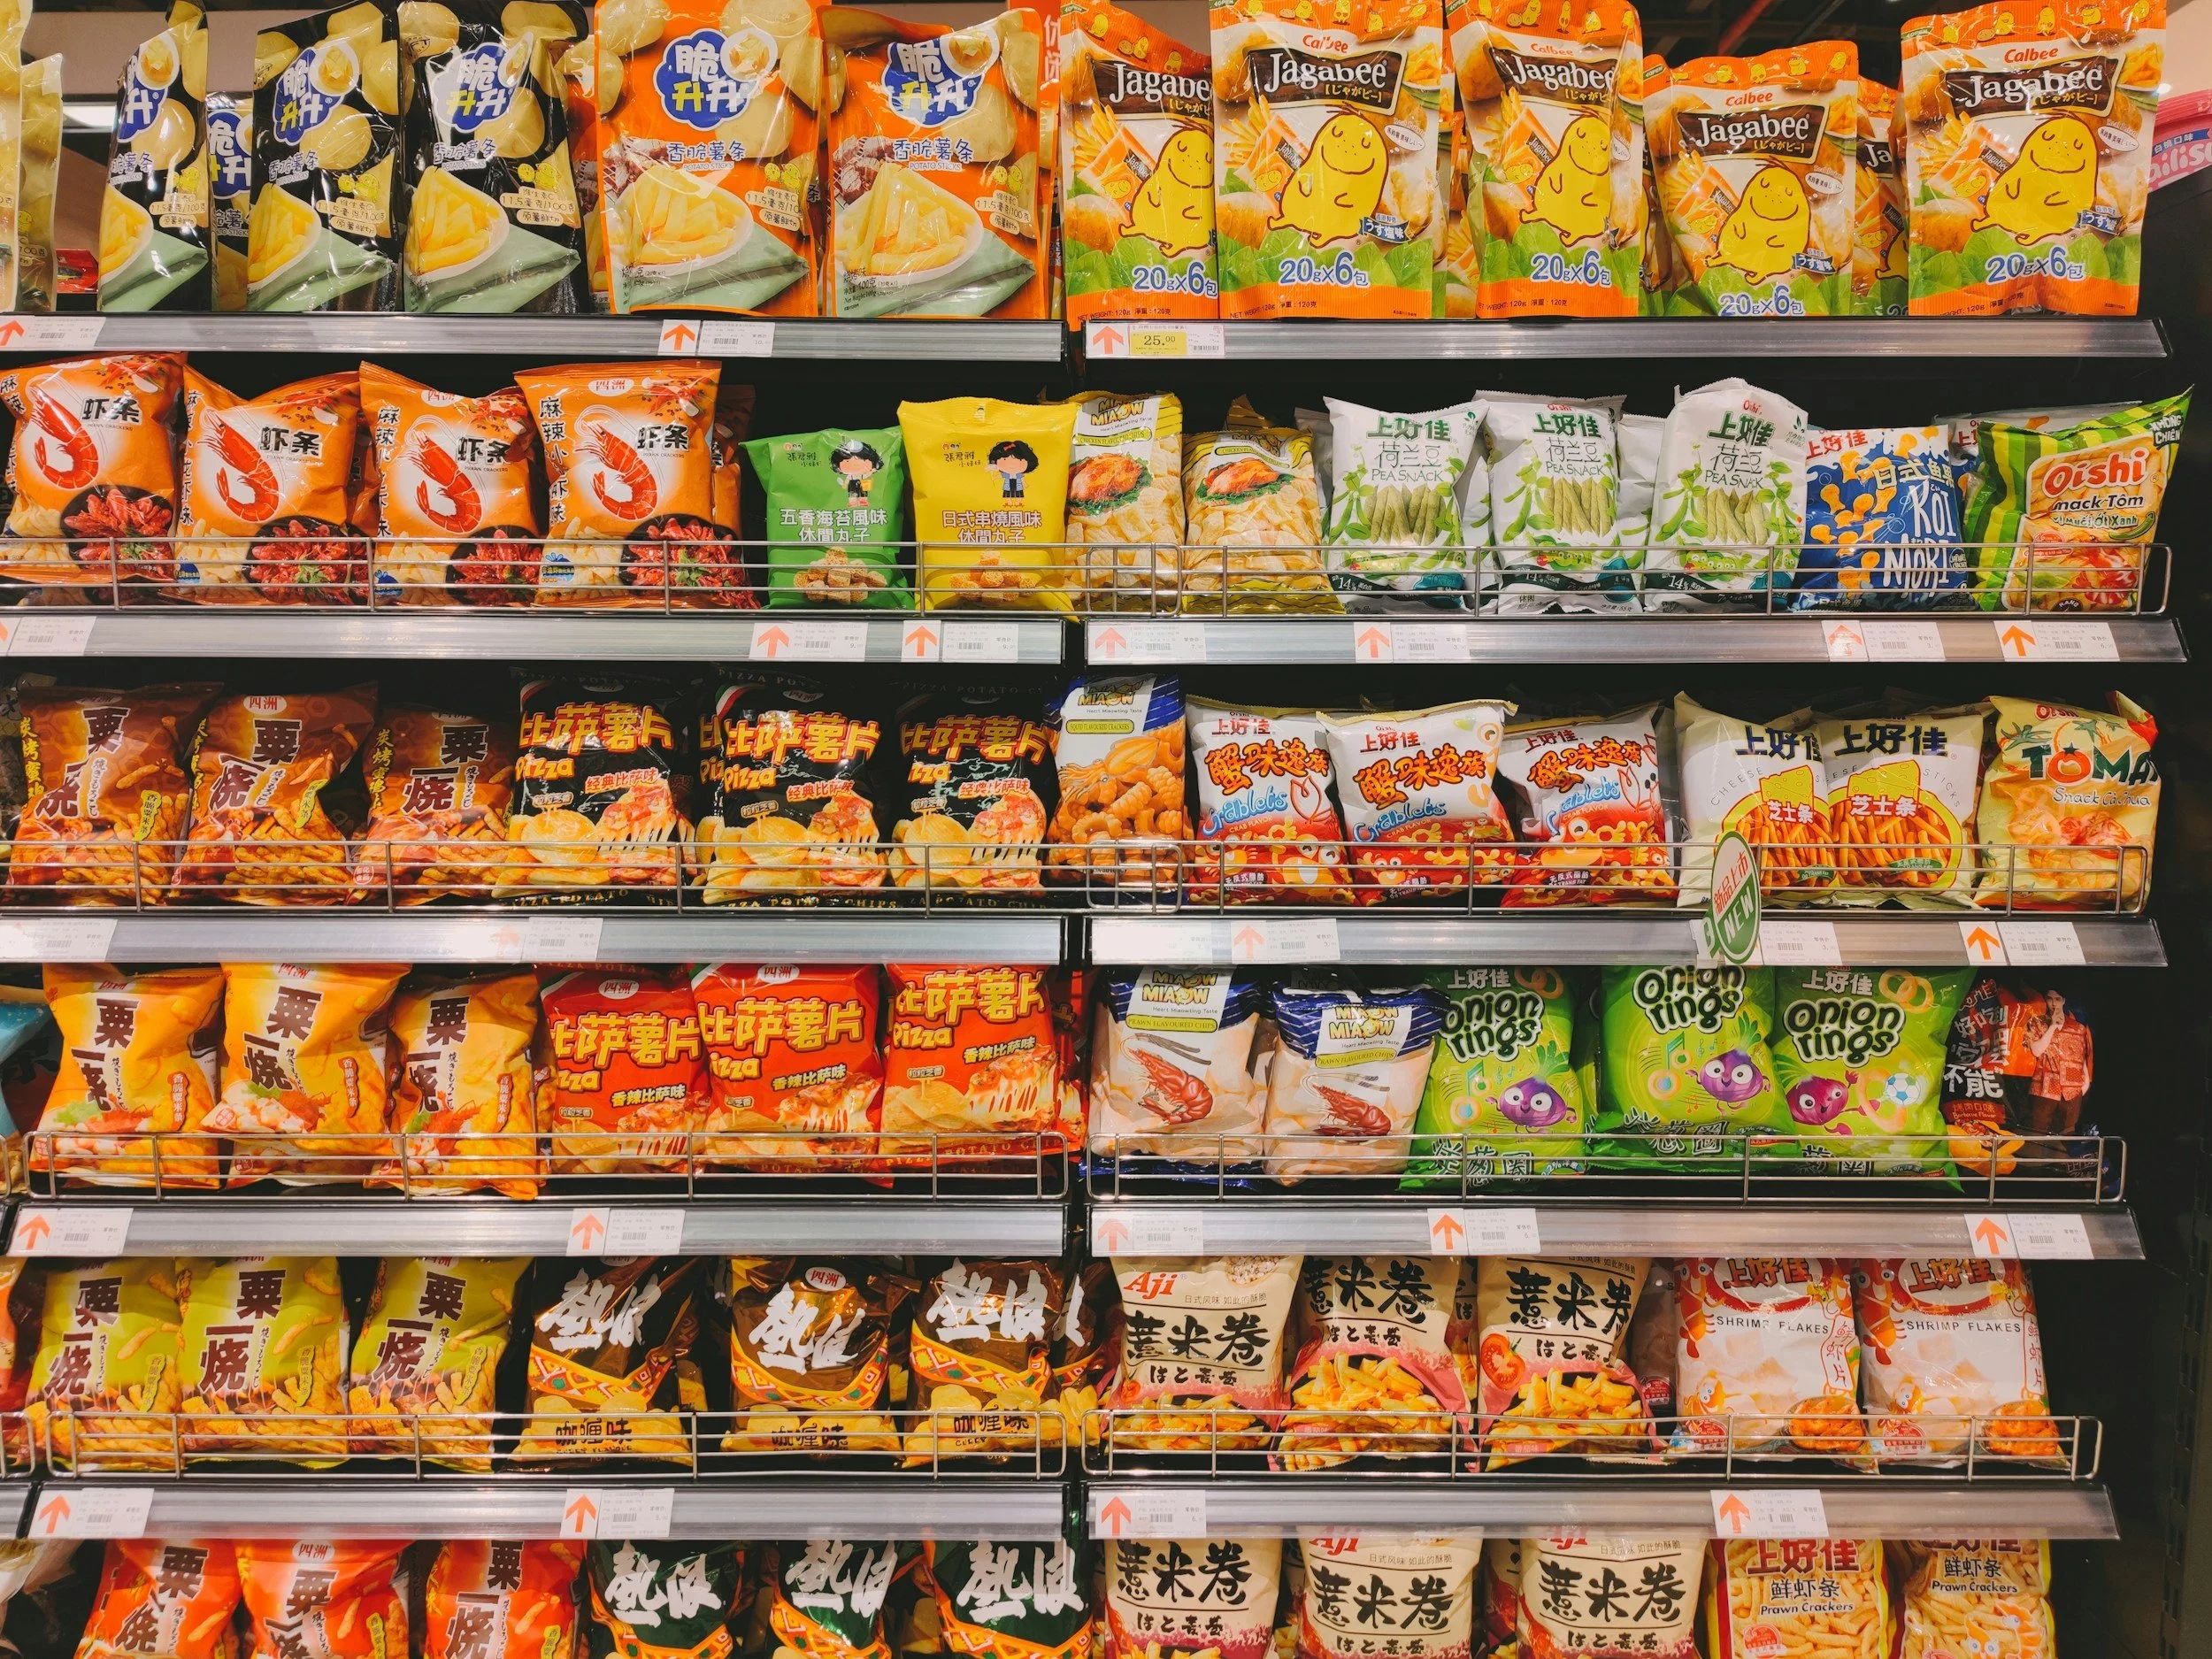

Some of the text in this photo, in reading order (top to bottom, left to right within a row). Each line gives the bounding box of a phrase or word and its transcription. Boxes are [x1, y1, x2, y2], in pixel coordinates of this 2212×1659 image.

[1303, 34, 1348, 53] Calbee
[1531, 42, 1574, 56] Calbee
[2004, 47, 2059, 64] Calbee
[675, 40, 721, 82] 脆
[897, 42, 944, 83] 脆
[1264, 53, 1388, 90] Jagabee
[1512, 54, 1616, 90] Jagabee
[672, 80, 746, 112] 升升
[899, 80, 968, 112] 升升
[1725, 91, 1773, 107] Calbee
[1965, 66, 2104, 107] Jagabee
[1695, 113, 1811, 148] Jagabee
[668, 141, 746, 162] 香脆薯条
[894, 138, 973, 162] 香脆薯条
[2154, 133, 2194, 155] 白桃口味
[1143, 333, 1176, 347] 25.00
[82, 397, 142, 423] 虾条
[1090, 401, 1144, 426] MIAOW
[636, 424, 691, 451] 虾条
[1366, 417, 1453, 442] 上好佳
[1532, 412, 1602, 439] 上好佳
[2155, 430, 2180, 445] CHIÊN
[259, 425, 322, 458] 虾条
[457, 435, 511, 465] 虾条
[1546, 438, 1602, 463] 荷兰豆
[1806, 429, 1869, 459] 上好佳
[943, 451, 975, 463] 張君雅
[1375, 442, 1442, 469] 荷兰豆
[1371, 468, 1444, 483] PEA SNACK
[1546, 461, 1606, 477] PEA SNACK
[1704, 469, 1729, 487] PEA
[2042, 449, 2150, 497] Oishi
[1909, 480, 1957, 537] KOI
[2108, 494, 2144, 508] Tôm
[780, 509, 888, 526] 五香海苔風味
[942, 511, 1042, 528] 日式串燒風味
[2109, 516, 2138, 529] Xanh
[249, 695, 278, 710] 四洲
[1078, 692, 1135, 706] MIAOW
[519, 704, 673, 753] 比萨薯片
[723, 713, 882, 764] 比萨薯片
[901, 717, 1047, 762] 比萨薯片
[1211, 718, 1271, 736] 上好佳
[1360, 730, 1421, 754] 上好佳
[1525, 729, 1578, 754] 上好佳
[1834, 723, 1948, 757] 上好佳
[516, 756, 573, 780] Pizza
[1204, 737, 1329, 795] 蟹味逸族
[1353, 743, 1487, 810] 蟹味逸族
[585, 768, 658, 793] 经典比萨味
[724, 766, 778, 793] Pizza
[786, 780, 855, 802] 经典比萨味
[957, 780, 1031, 800] 经典比萨味
[1710, 765, 1763, 807] CHEESE
[1922, 767, 1962, 808] STICKS
[1850, 795, 1917, 818] 芝士条
[2054, 786, 2100, 805] Snack
[1202, 786, 1288, 837] Crablets
[1353, 798, 1447, 843] Crablets
[1583, 803, 1609, 815] FLAVOR
[1769, 801, 1815, 825] 芝士条
[1228, 816, 1273, 833] CRAB FLAVOR
[1386, 818, 1432, 839] CRAB FLAVOR
[1548, 869, 1590, 887] 无反式脂肪
[1713, 849, 1749, 916] 新品上市
[1723, 887, 1755, 945] NEW
[764, 965, 793, 979] 四洲
[1447, 969, 1511, 990] 上好佳
[1801, 970, 1874, 996] 上好佳
[603, 983, 633, 995] 四洲
[895, 968, 1045, 1023] 比萨薯片
[1142, 984, 1210, 1004] MIAOW
[1440, 991, 1543, 1033] onion
[1649, 987, 1743, 1033] rings
[1787, 997, 1901, 1035] onion
[700, 1000, 864, 1054] 比萨薯片
[894, 1023, 954, 1048] Pizza
[1128, 1017, 1217, 1031] PRAWN FLAVOURED CHIPS
[1329, 1019, 1395, 1040] MIAOW
[964, 1036, 1035, 1064] 香辣比萨味
[1451, 1016, 1543, 1060] rings
[1796, 1025, 1895, 1067] rings
[1340, 1054, 1374, 1066] FLAVOURED
[1373, 1051, 1395, 1063] CHIPS
[773, 1064, 847, 1090] 香辣比萨味
[1943, 1064, 2004, 1099] 不能
[611, 1085, 686, 1106] 香辣比萨味
[810, 1269, 841, 1287] 四洲
[1724, 1257, 1814, 1288] 上好佳
[1908, 1257, 1996, 1293] 上好佳
[1124, 1271, 1178, 1300] Aji
[1184, 1292, 1267, 1305] 日式风味 如此的酥脆
[199, 1269, 286, 1394] 栗一烧
[374, 1271, 466, 1380] 栗一烧
[1778, 1321, 1830, 1334] FLAKES
[1906, 1320, 2022, 1333] SHRIMP FLAKES
[297, 1543, 328, 1561] 四洲
[1370, 1552, 1453, 1566] 日式风味 如此的酥脆
[1637, 1540, 1682, 1555] 如此的酥脆
[1747, 1539, 1862, 1576] 上好佳
[1944, 1556, 2002, 1578] 鲜虾条
[1770, 1578, 1840, 1601] 鲜虾条
[1932, 1579, 2019, 1594] Prawn Crackers
[1760, 1601, 1855, 1616] Prawn Crackers
